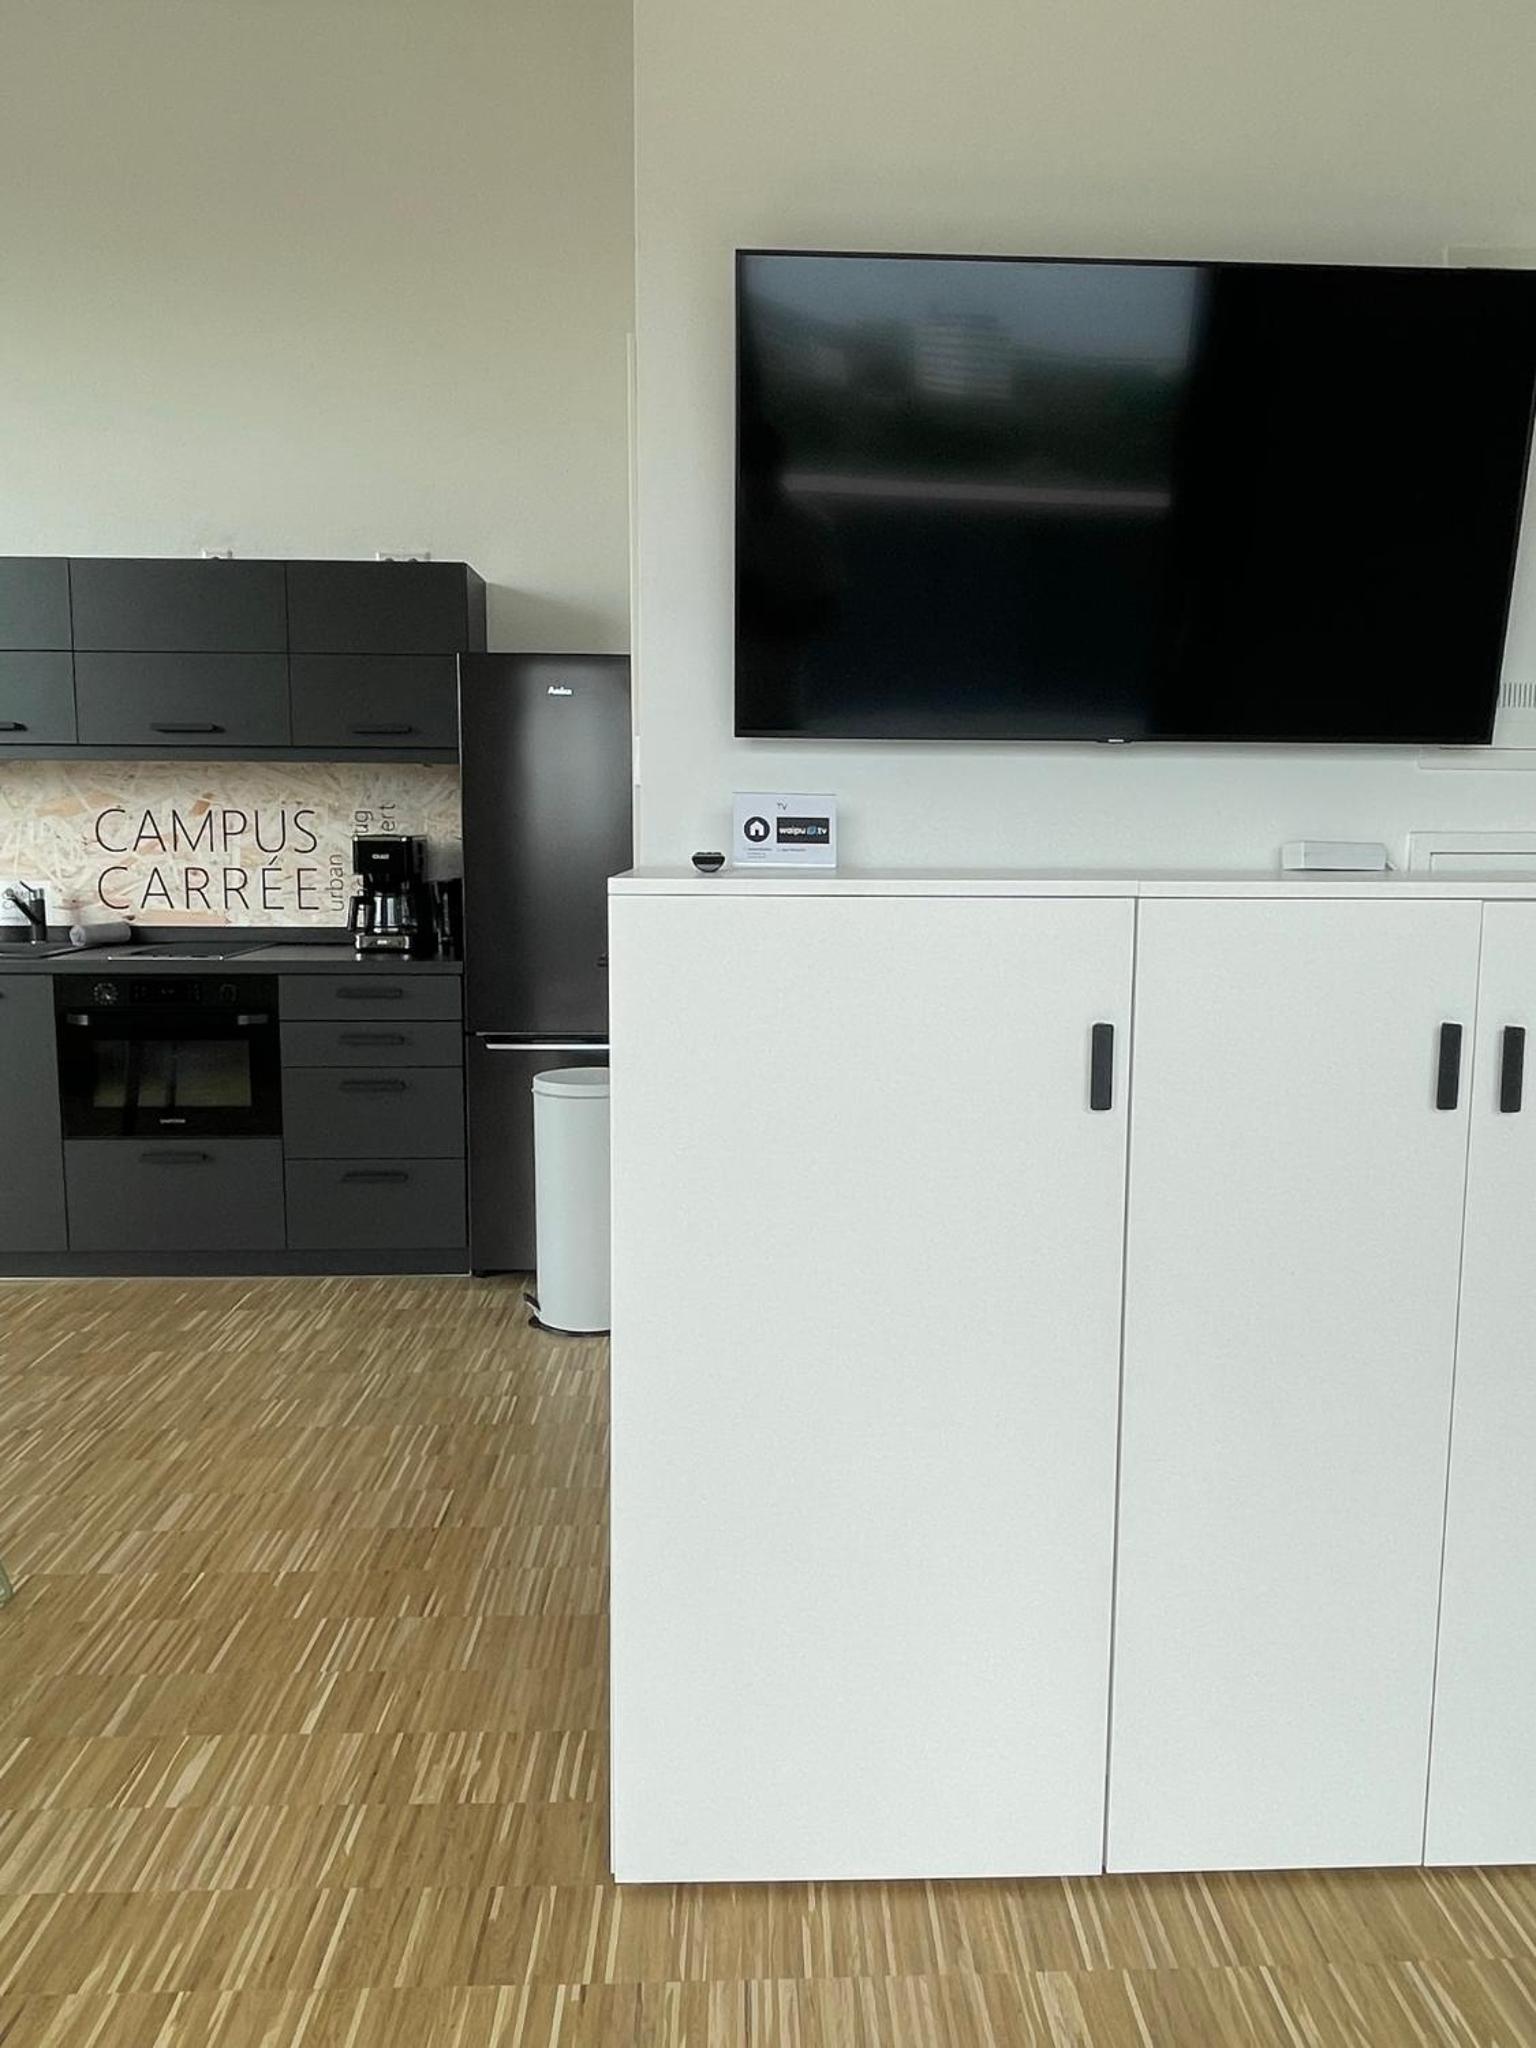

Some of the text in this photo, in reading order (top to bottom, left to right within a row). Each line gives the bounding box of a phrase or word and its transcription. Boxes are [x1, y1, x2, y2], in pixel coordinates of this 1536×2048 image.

[95, 809, 318, 854] CAMPUS
[98, 856, 320, 912] CARRÉE
[330, 854, 344, 912] urban
